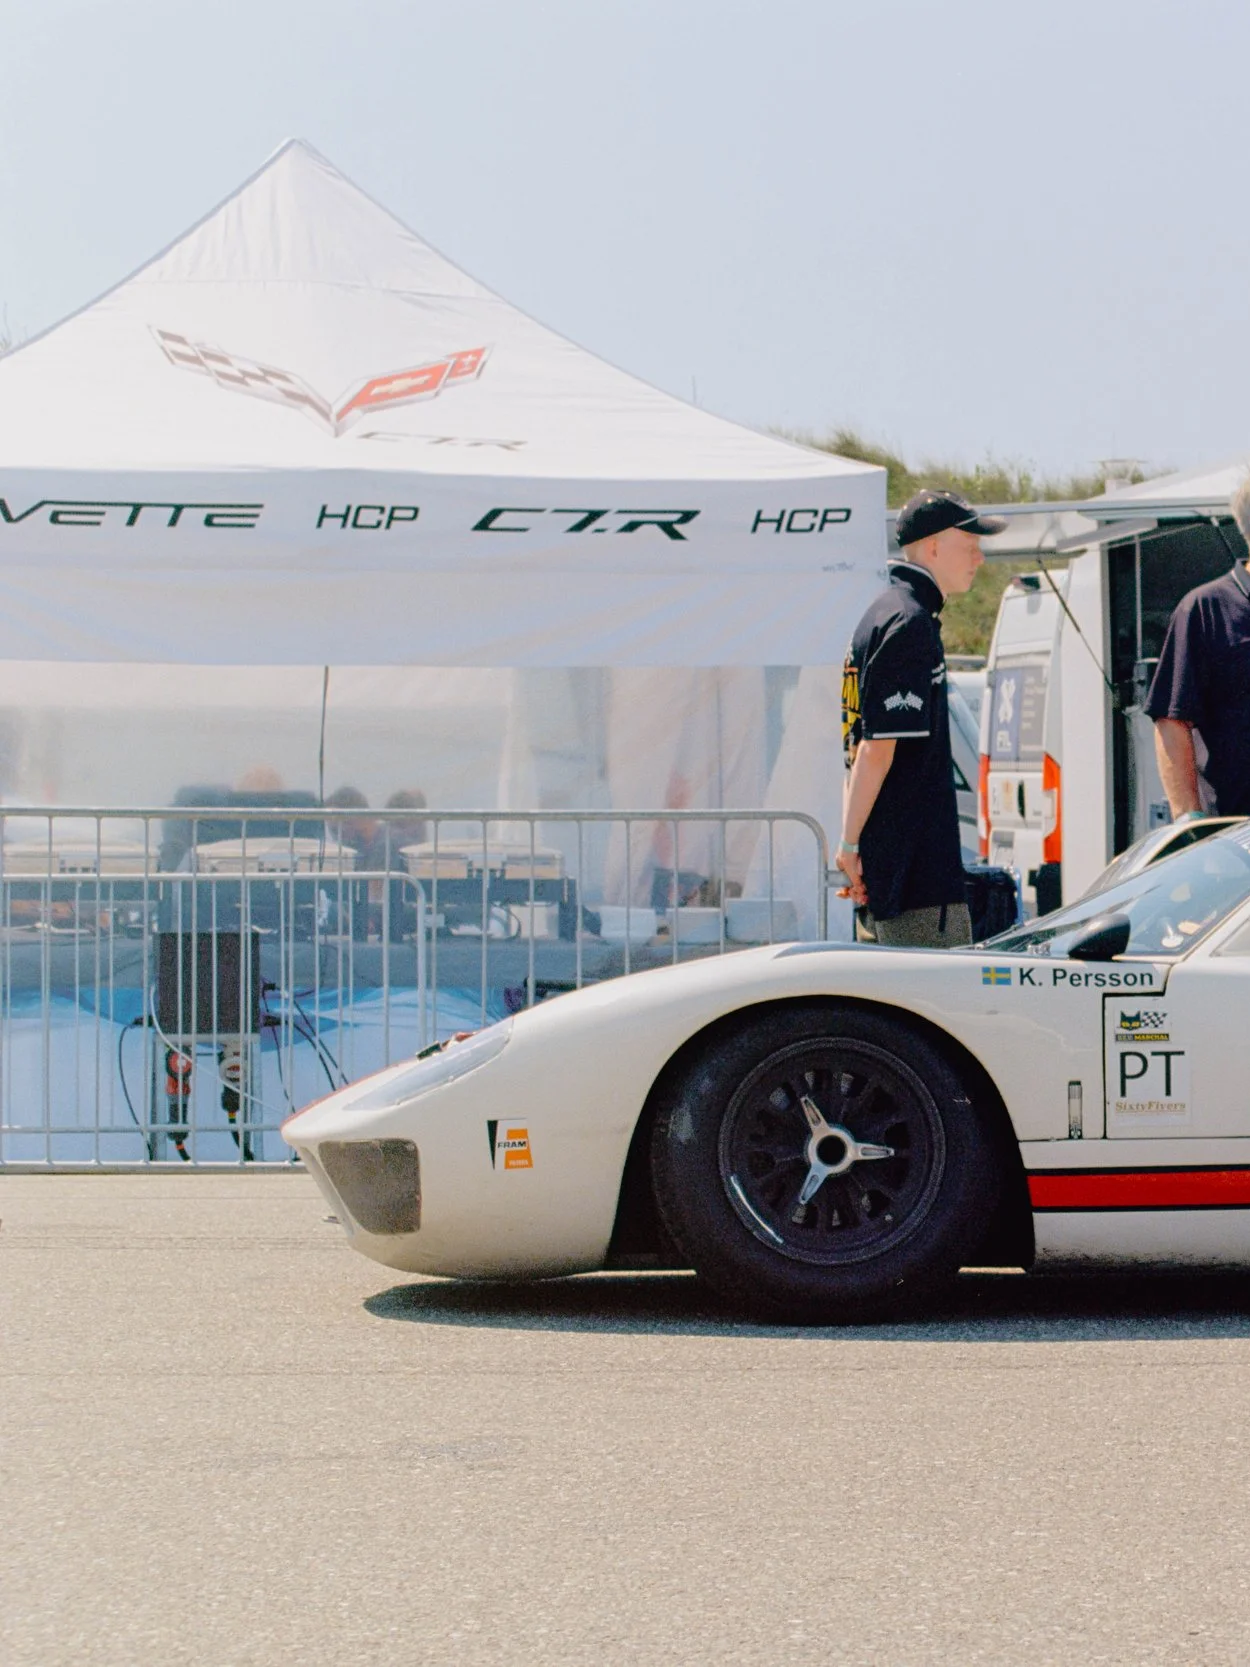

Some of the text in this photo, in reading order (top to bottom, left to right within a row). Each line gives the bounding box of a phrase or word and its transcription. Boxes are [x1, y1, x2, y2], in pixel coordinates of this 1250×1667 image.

[316, 504, 420, 530] HCP
[751, 508, 852, 534] HCP
[1019, 967, 1154, 987] K. Persson
[1120, 1051, 1185, 1098] PT
